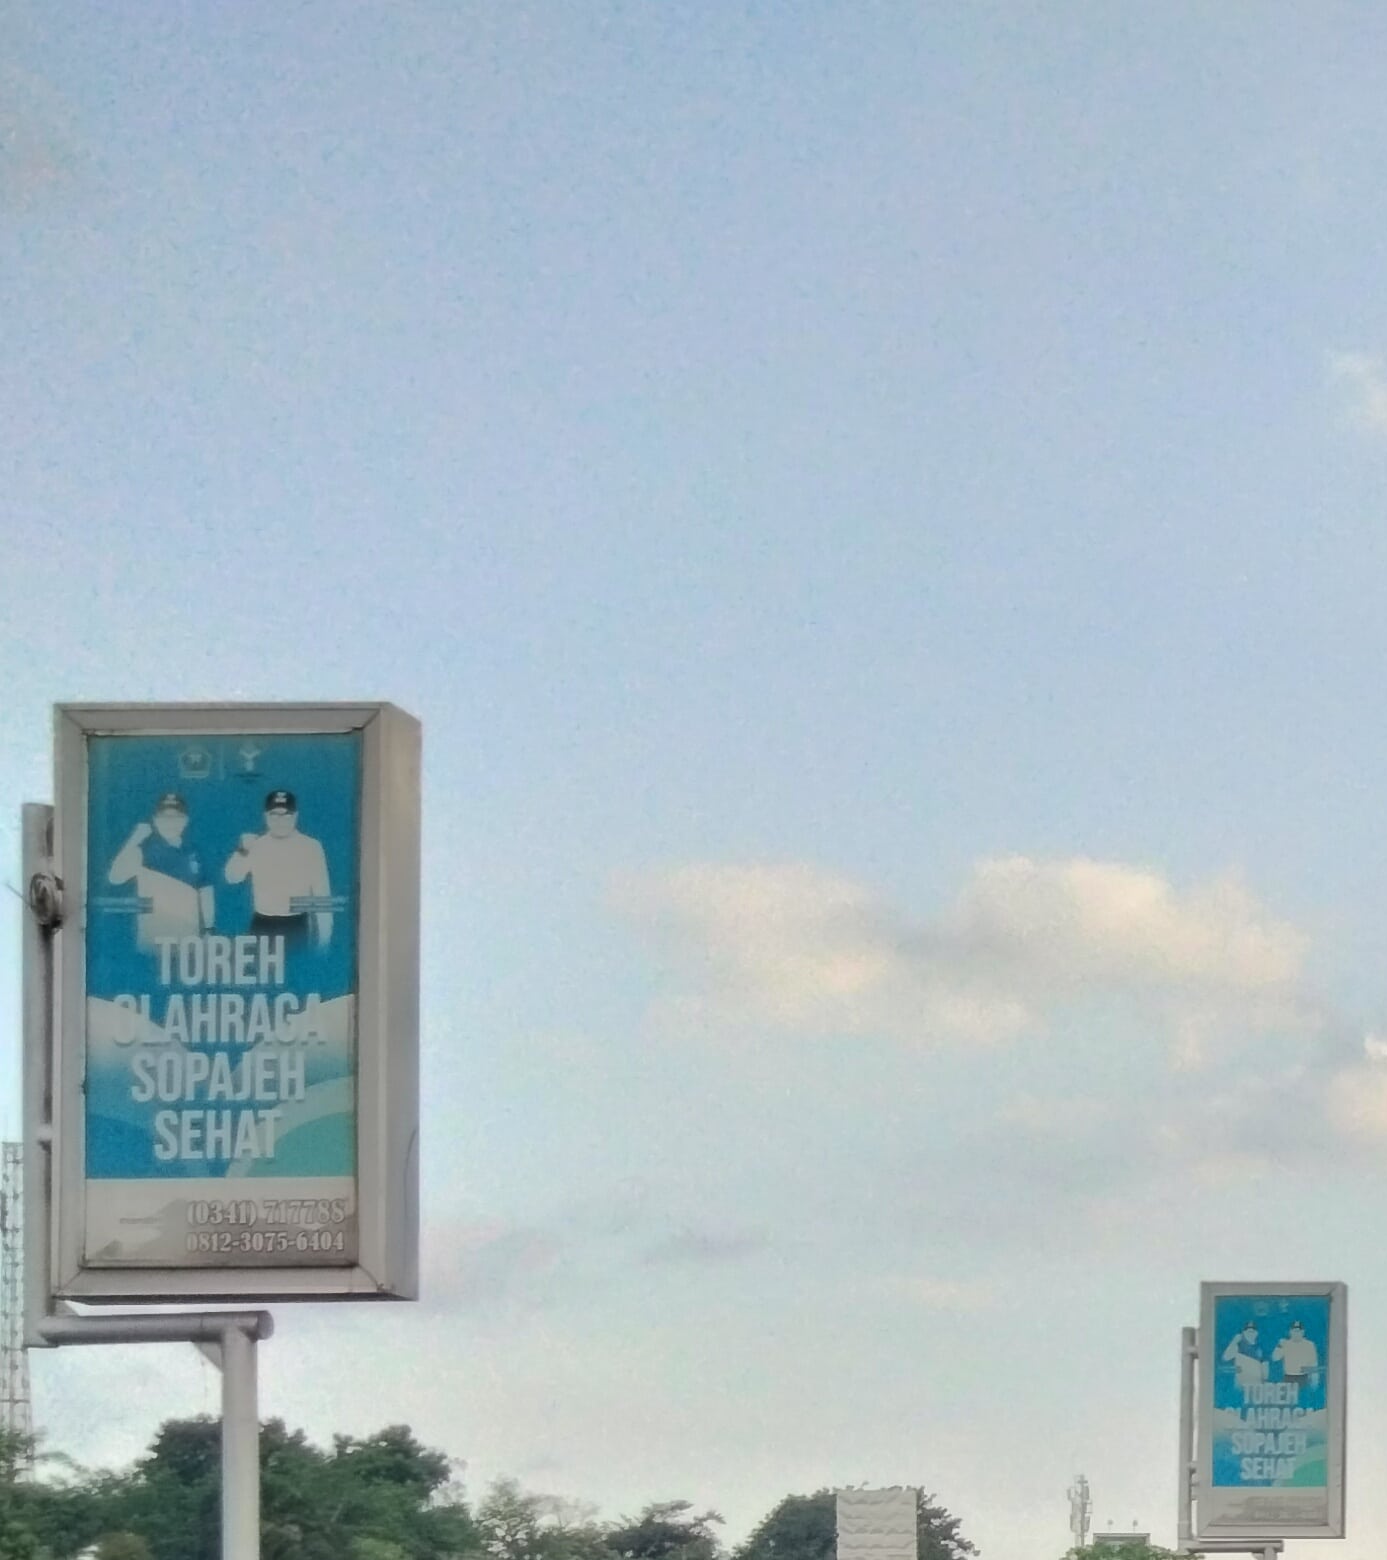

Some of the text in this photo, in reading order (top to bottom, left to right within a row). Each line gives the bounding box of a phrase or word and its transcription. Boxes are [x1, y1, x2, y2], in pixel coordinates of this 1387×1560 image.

[154, 935, 286, 985] TOREH
[113, 993, 328, 1045] OLAHRAGA
[131, 1051, 306, 1102] SOPAJEH
[154, 1109, 282, 1160] SEHAT
[187, 1200, 345, 1228] (0341) 717788
[186, 1230, 345, 1253] 0812-3075-6404
